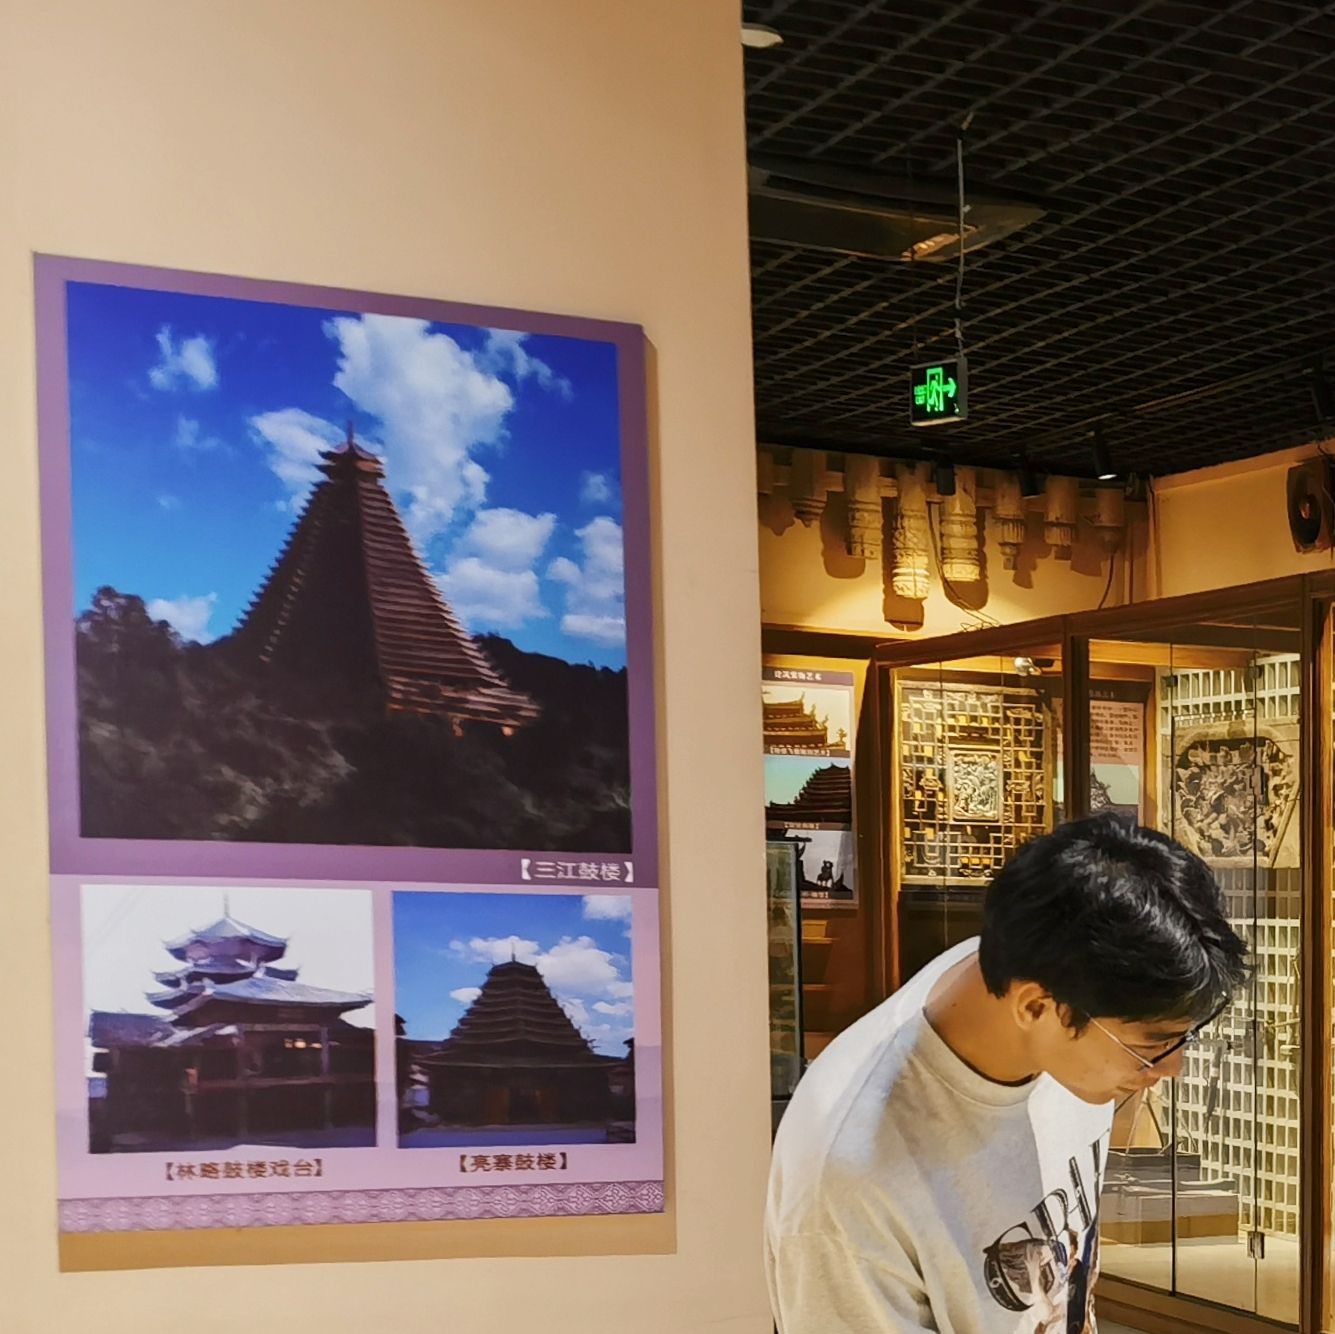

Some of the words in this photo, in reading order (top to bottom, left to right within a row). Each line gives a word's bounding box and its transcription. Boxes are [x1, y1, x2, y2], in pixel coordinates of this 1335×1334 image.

[520, 858, 634, 883] 【三江鼓楼】
[459, 1151, 568, 1173] 【亮寨鼓楼】
